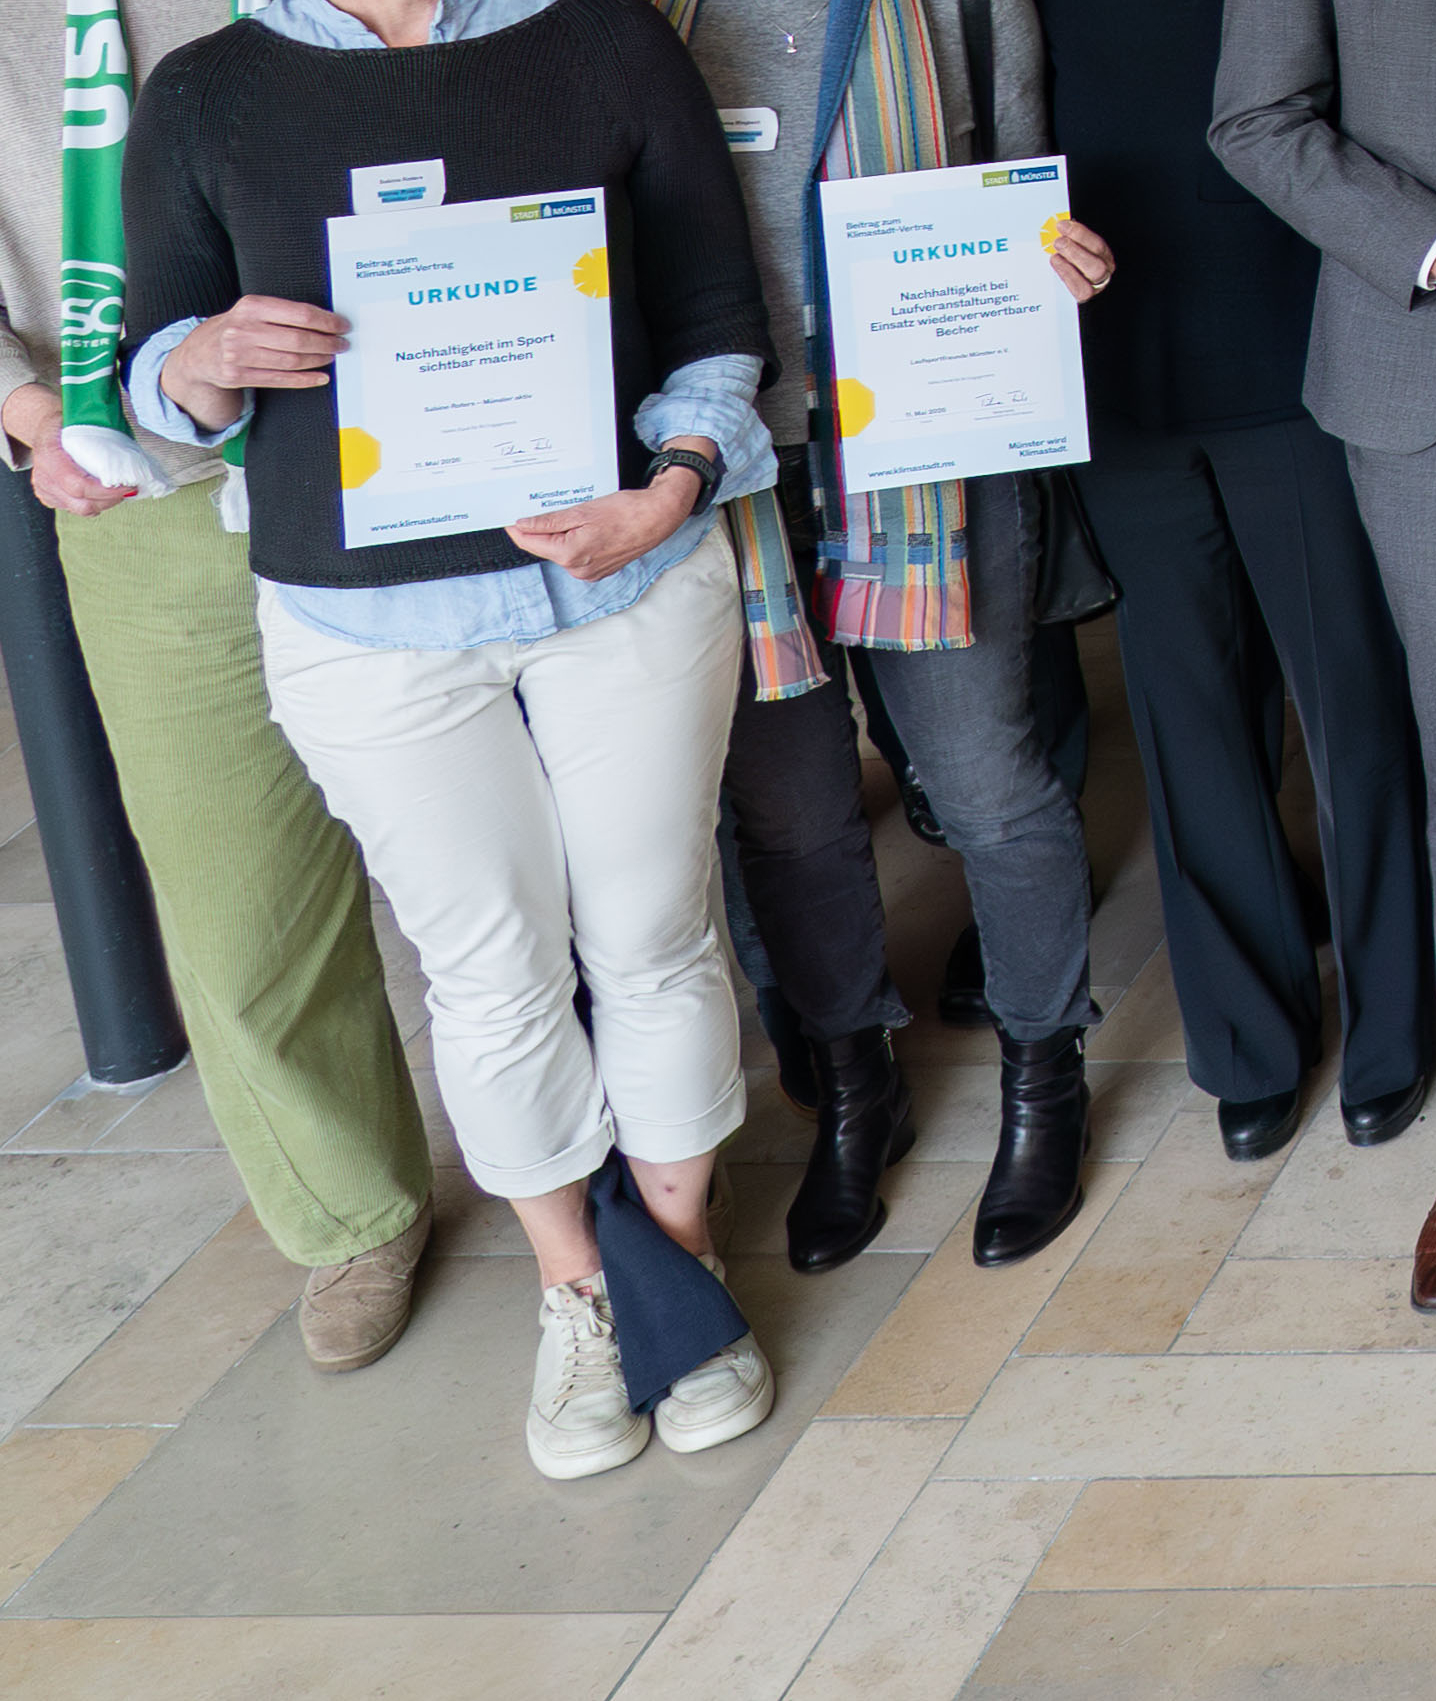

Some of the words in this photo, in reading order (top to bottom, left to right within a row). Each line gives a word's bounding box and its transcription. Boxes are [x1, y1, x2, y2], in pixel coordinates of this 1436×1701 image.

[1019, 169, 1055, 181] MÜNSTER
[552, 202, 593, 215] MÜNSTER
[845, 220, 880, 230] Beitrag
[880, 218, 901, 226] zum
[846, 223, 933, 238] Klimastadt-Vertrag
[892, 237, 1008, 264] URKUNDE
[355, 259, 394, 269] Beitrag
[395, 256, 417, 265] zum
[355, 261, 454, 278] Klimastadt-Vertrag
[407, 275, 537, 305] URKUNDE
[899, 282, 987, 301] Nachhaltigkeit
[989, 279, 1008, 291] bei
[890, 294, 1019, 316] Laufveranstaltungen:
[60, 296, 124, 336] SC
[870, 318, 915, 332] Einsatz
[916, 304, 1041, 325] wiederverwertbarer
[935, 324, 979, 337] Becher
[61, 338, 111, 348] NSTER
[395, 340, 493, 361] Nachhaltigkeit
[496, 339, 513, 349] im
[516, 333, 554, 347] Sport
[418, 358, 476, 372] sichtbar
[478, 351, 533, 365] machen
[1008, 439, 1045, 449] Münster
[1046, 436, 1067, 445] wird
[867, 460, 955, 477] www.klimastadt.ms
[528, 489, 570, 500] Münster
[571, 484, 594, 494] wird
[370, 513, 469, 531] www.klimastadt.ms
